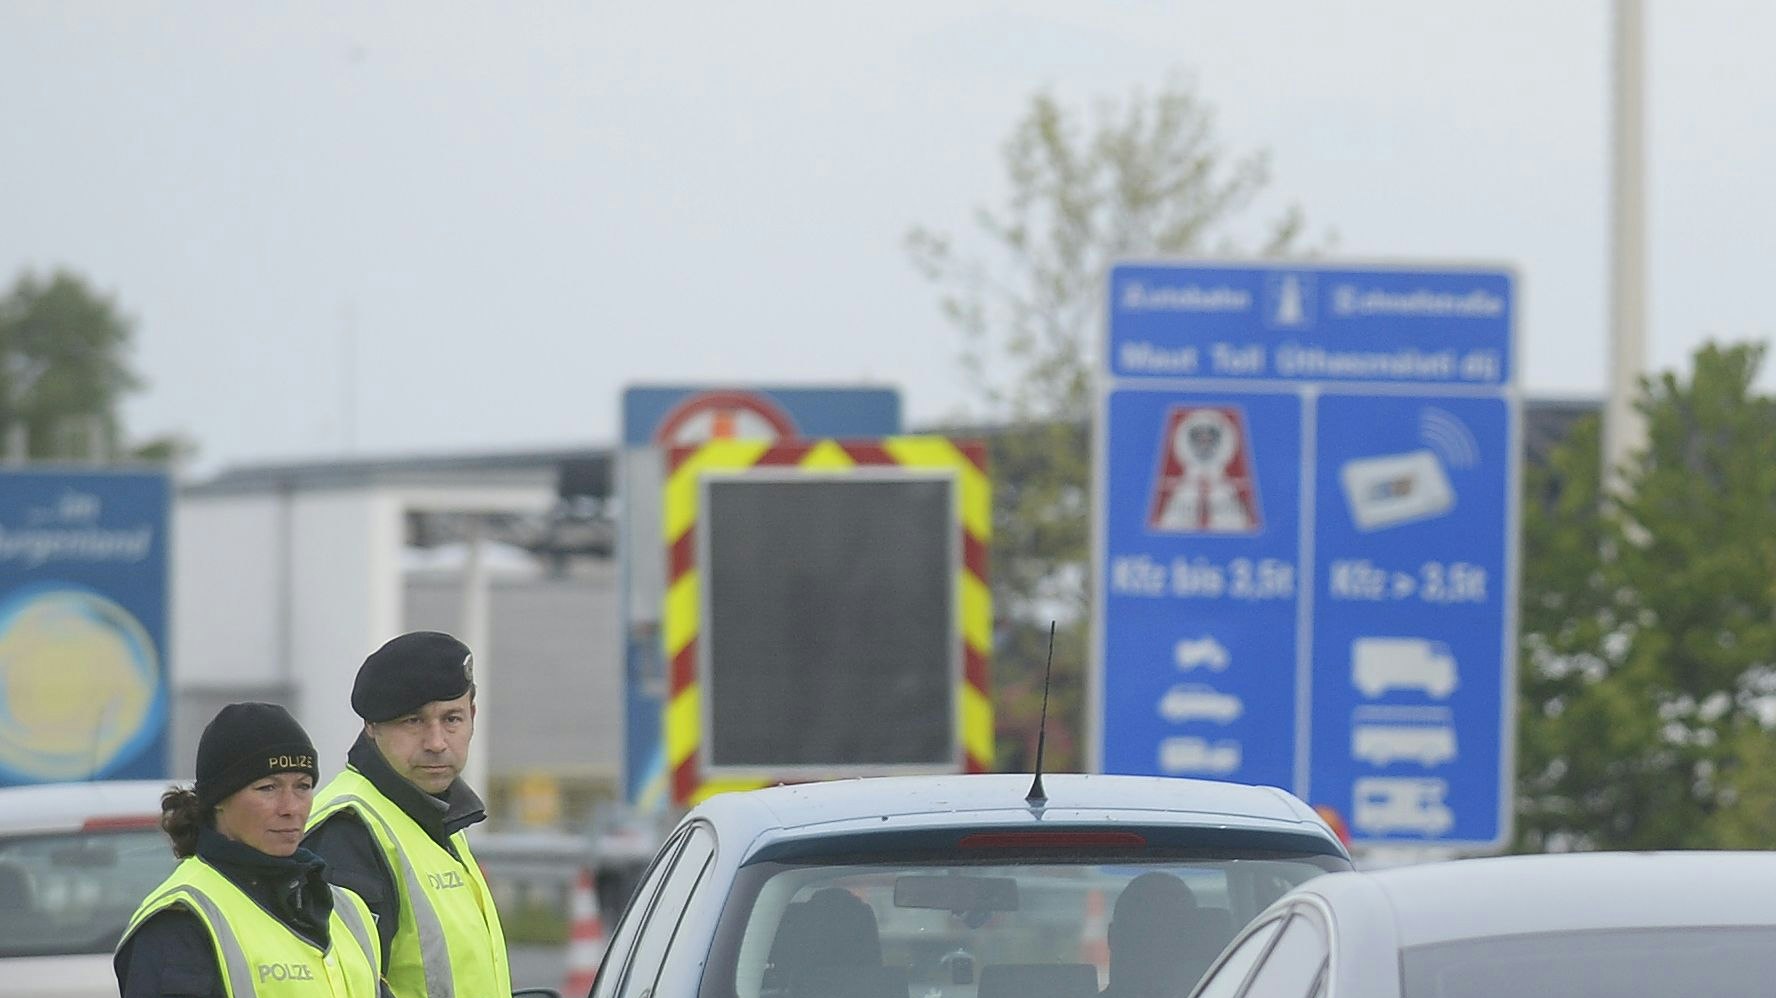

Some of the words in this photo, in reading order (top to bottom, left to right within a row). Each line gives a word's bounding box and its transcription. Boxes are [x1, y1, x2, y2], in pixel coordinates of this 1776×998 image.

[1113, 556, 1167, 597] Kfz
[1172, 556, 1225, 599] bis
[1330, 560, 1386, 600] Kfz
